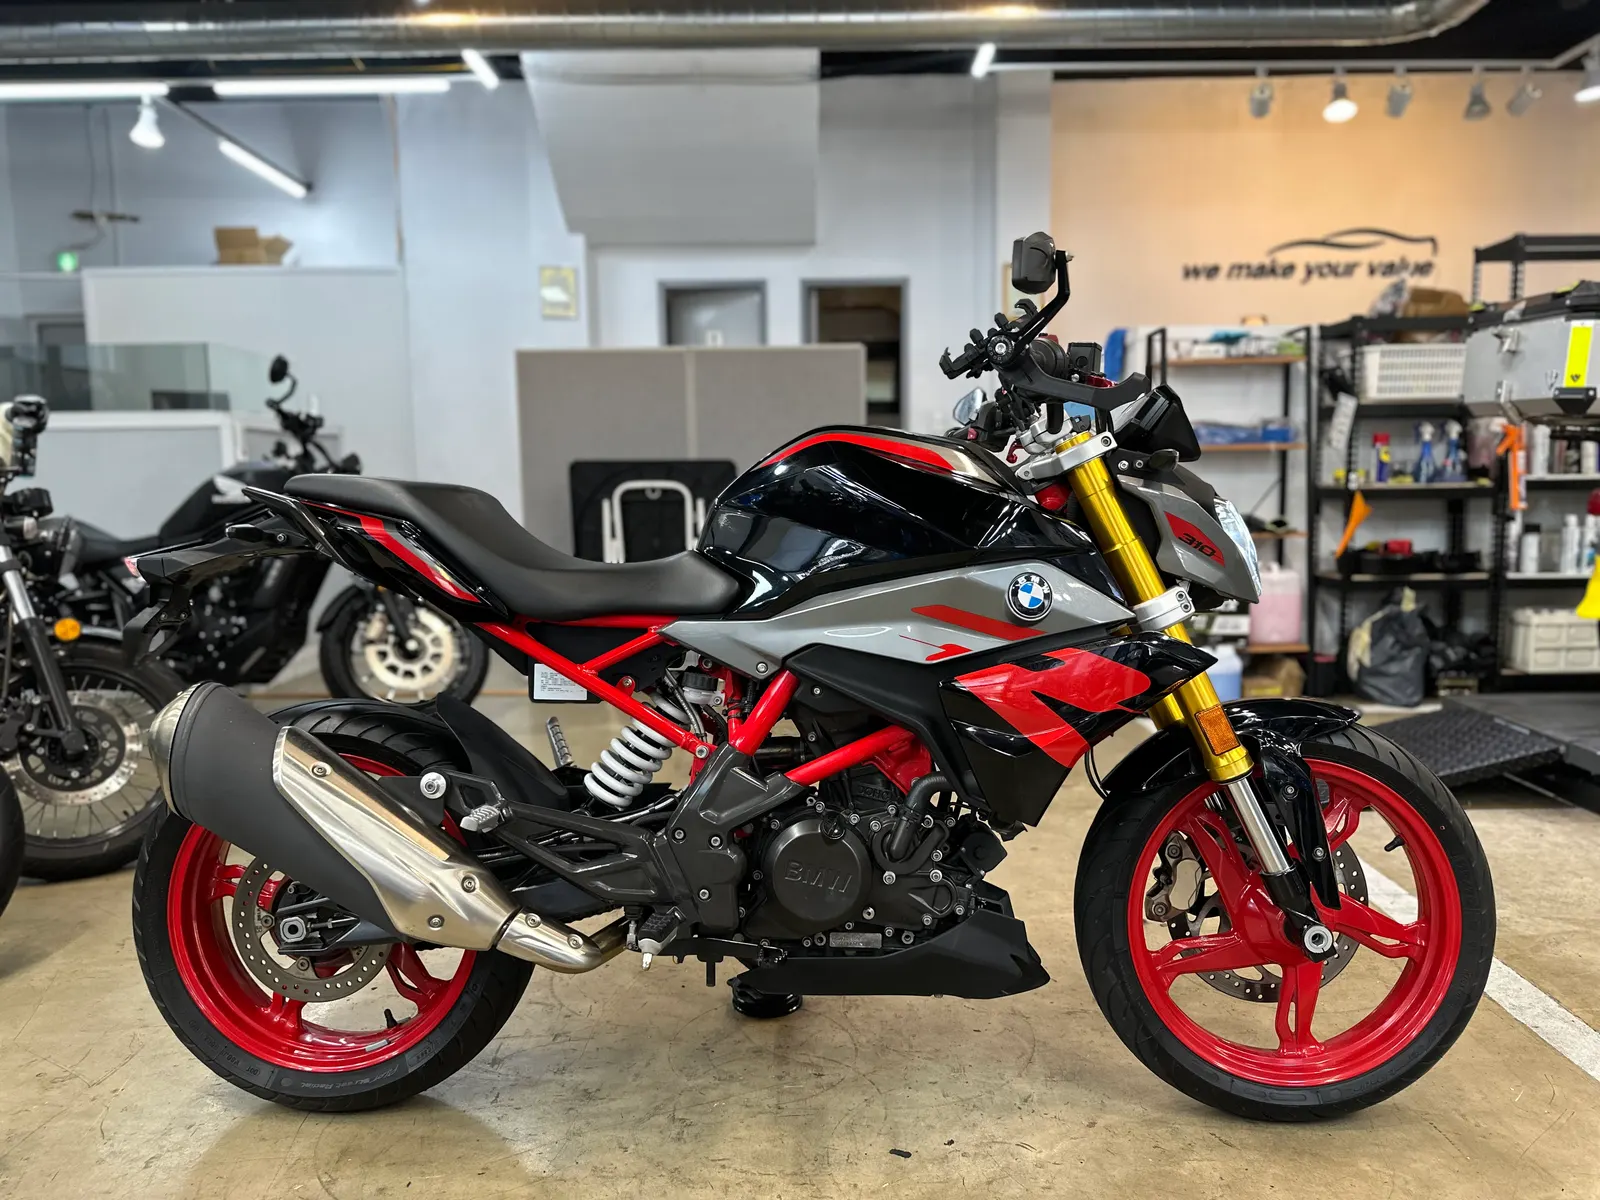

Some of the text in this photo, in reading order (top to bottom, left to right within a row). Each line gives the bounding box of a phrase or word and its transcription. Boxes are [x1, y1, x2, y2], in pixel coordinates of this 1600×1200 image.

[1182, 255, 1434, 286] we make your value
[1178, 533, 1217, 557] 310
[1016, 574, 1051, 594] BMW
[784, 860, 852, 894] BMW
